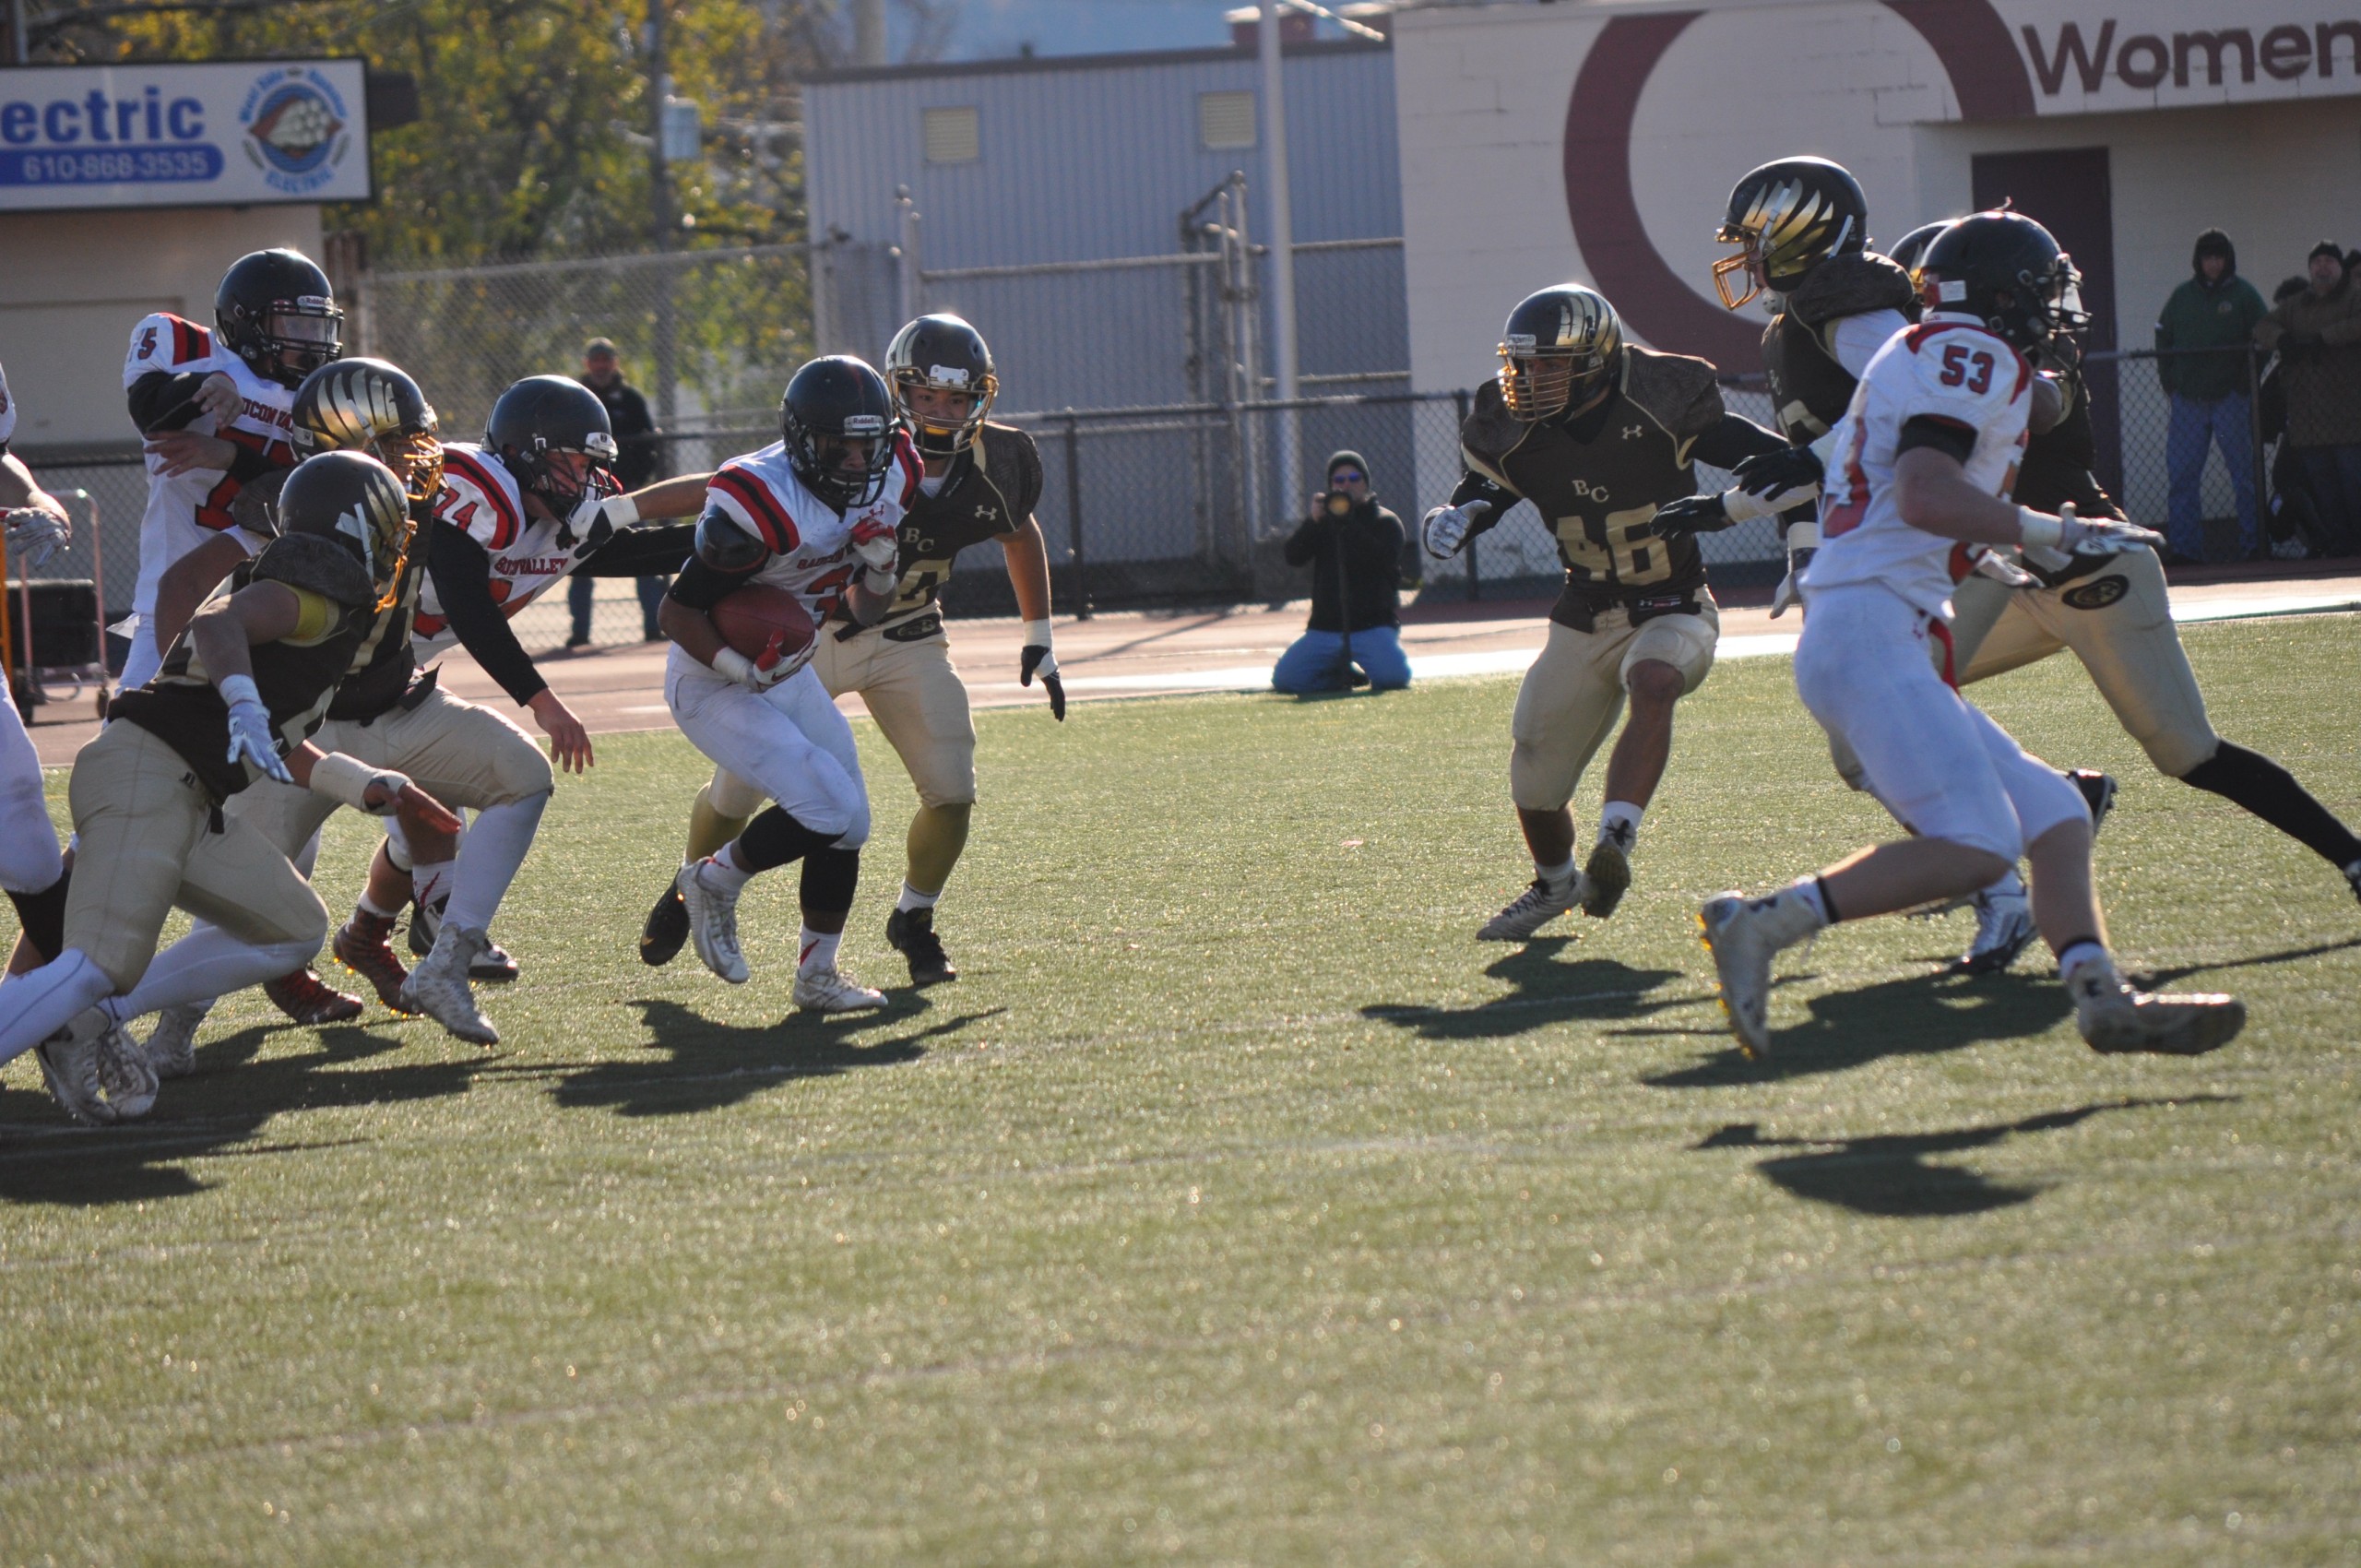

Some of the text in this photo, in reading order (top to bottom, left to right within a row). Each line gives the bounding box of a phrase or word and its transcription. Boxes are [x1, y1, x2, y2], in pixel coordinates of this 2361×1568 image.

[1, 85, 205, 144] ectric
[1940, 344, 1995, 395] 53
[432, 486, 480, 532] 74
[1572, 480, 1609, 503] BC
[903, 527, 934, 552] BC
[1556, 502, 1672, 586] 46
